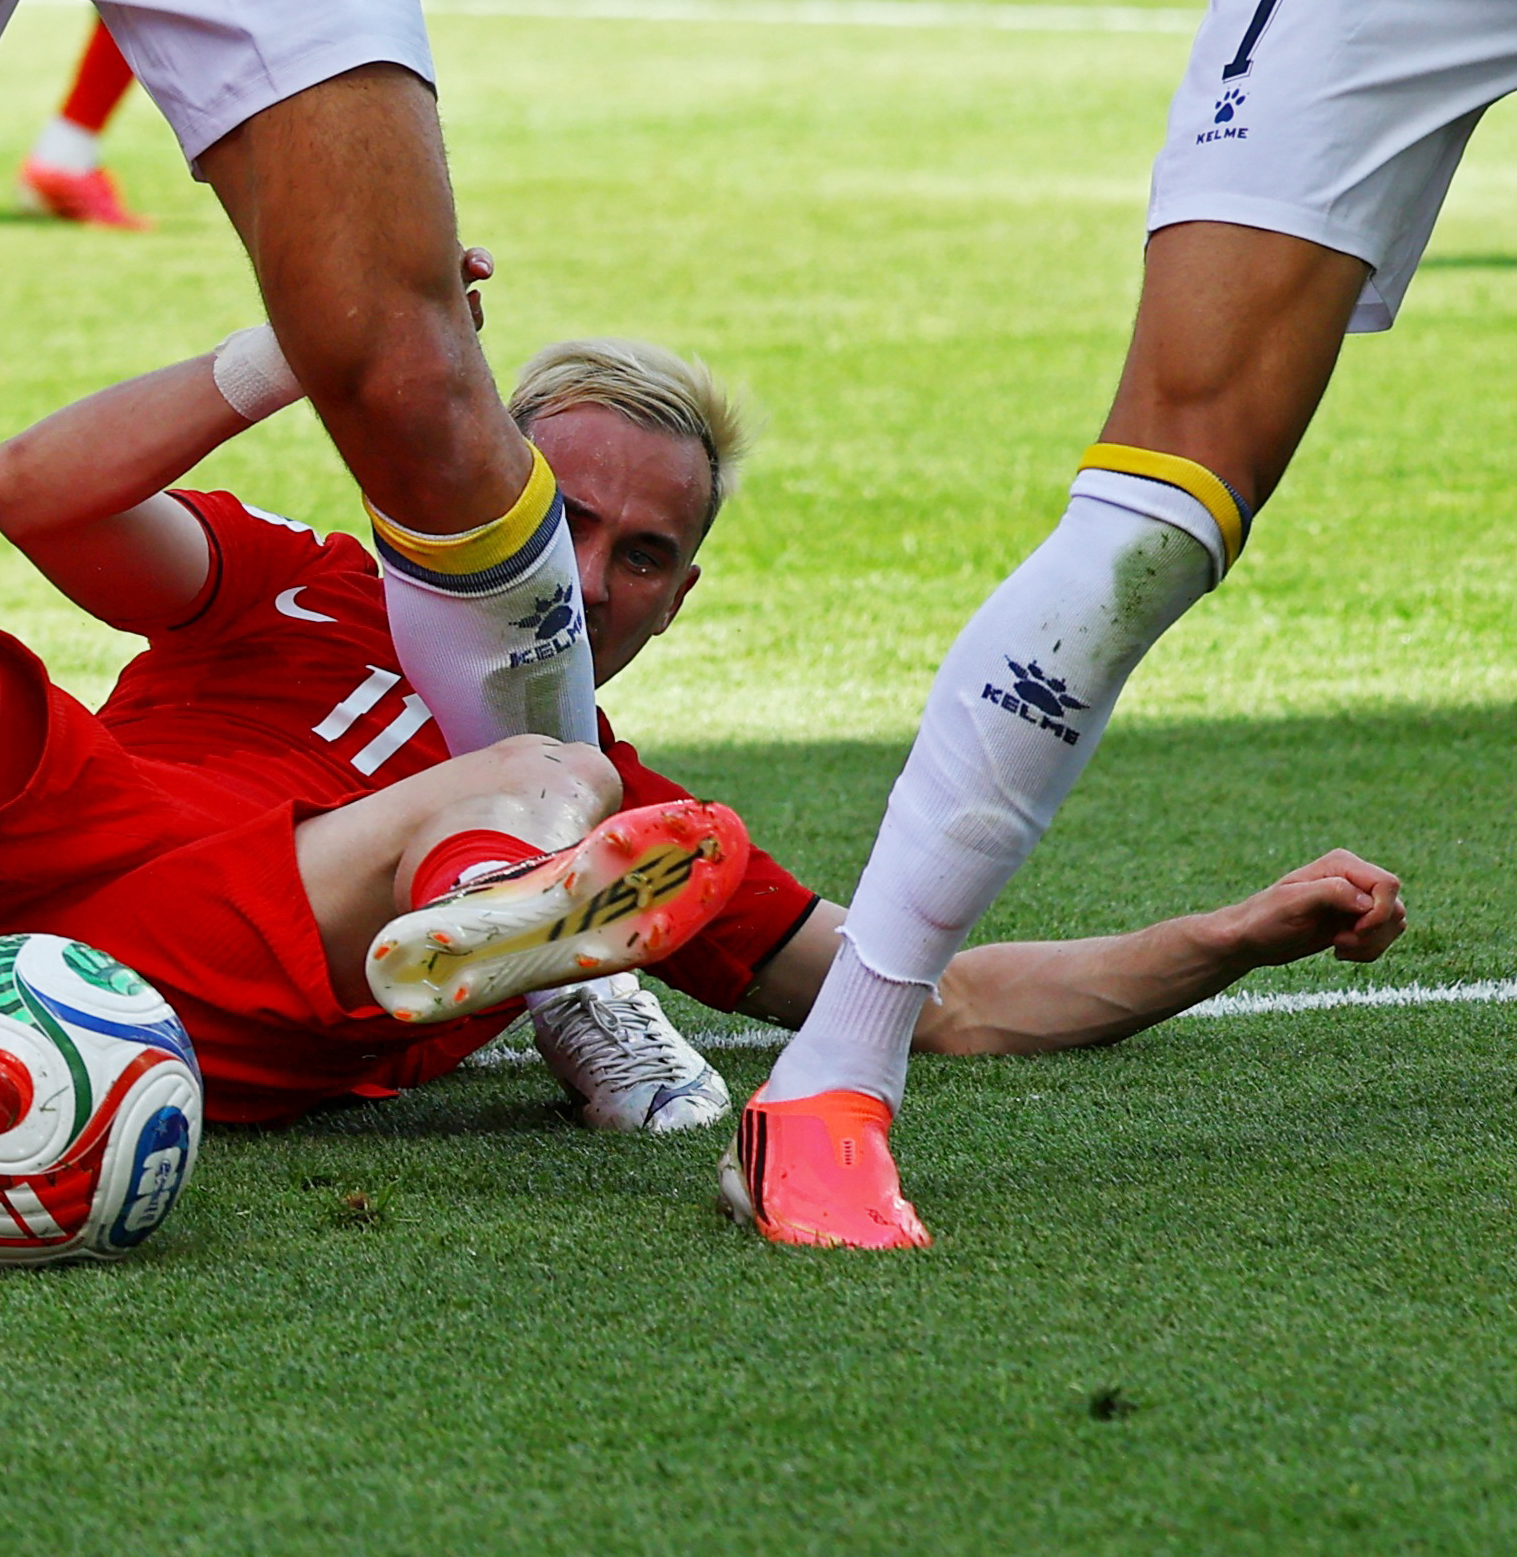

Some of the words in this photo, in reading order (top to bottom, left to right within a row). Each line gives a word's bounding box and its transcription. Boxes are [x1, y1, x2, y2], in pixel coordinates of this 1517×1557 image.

[1196, 128, 1249, 145] KELME
[311, 664, 433, 777] 11
[981, 683, 1081, 746] KELME
